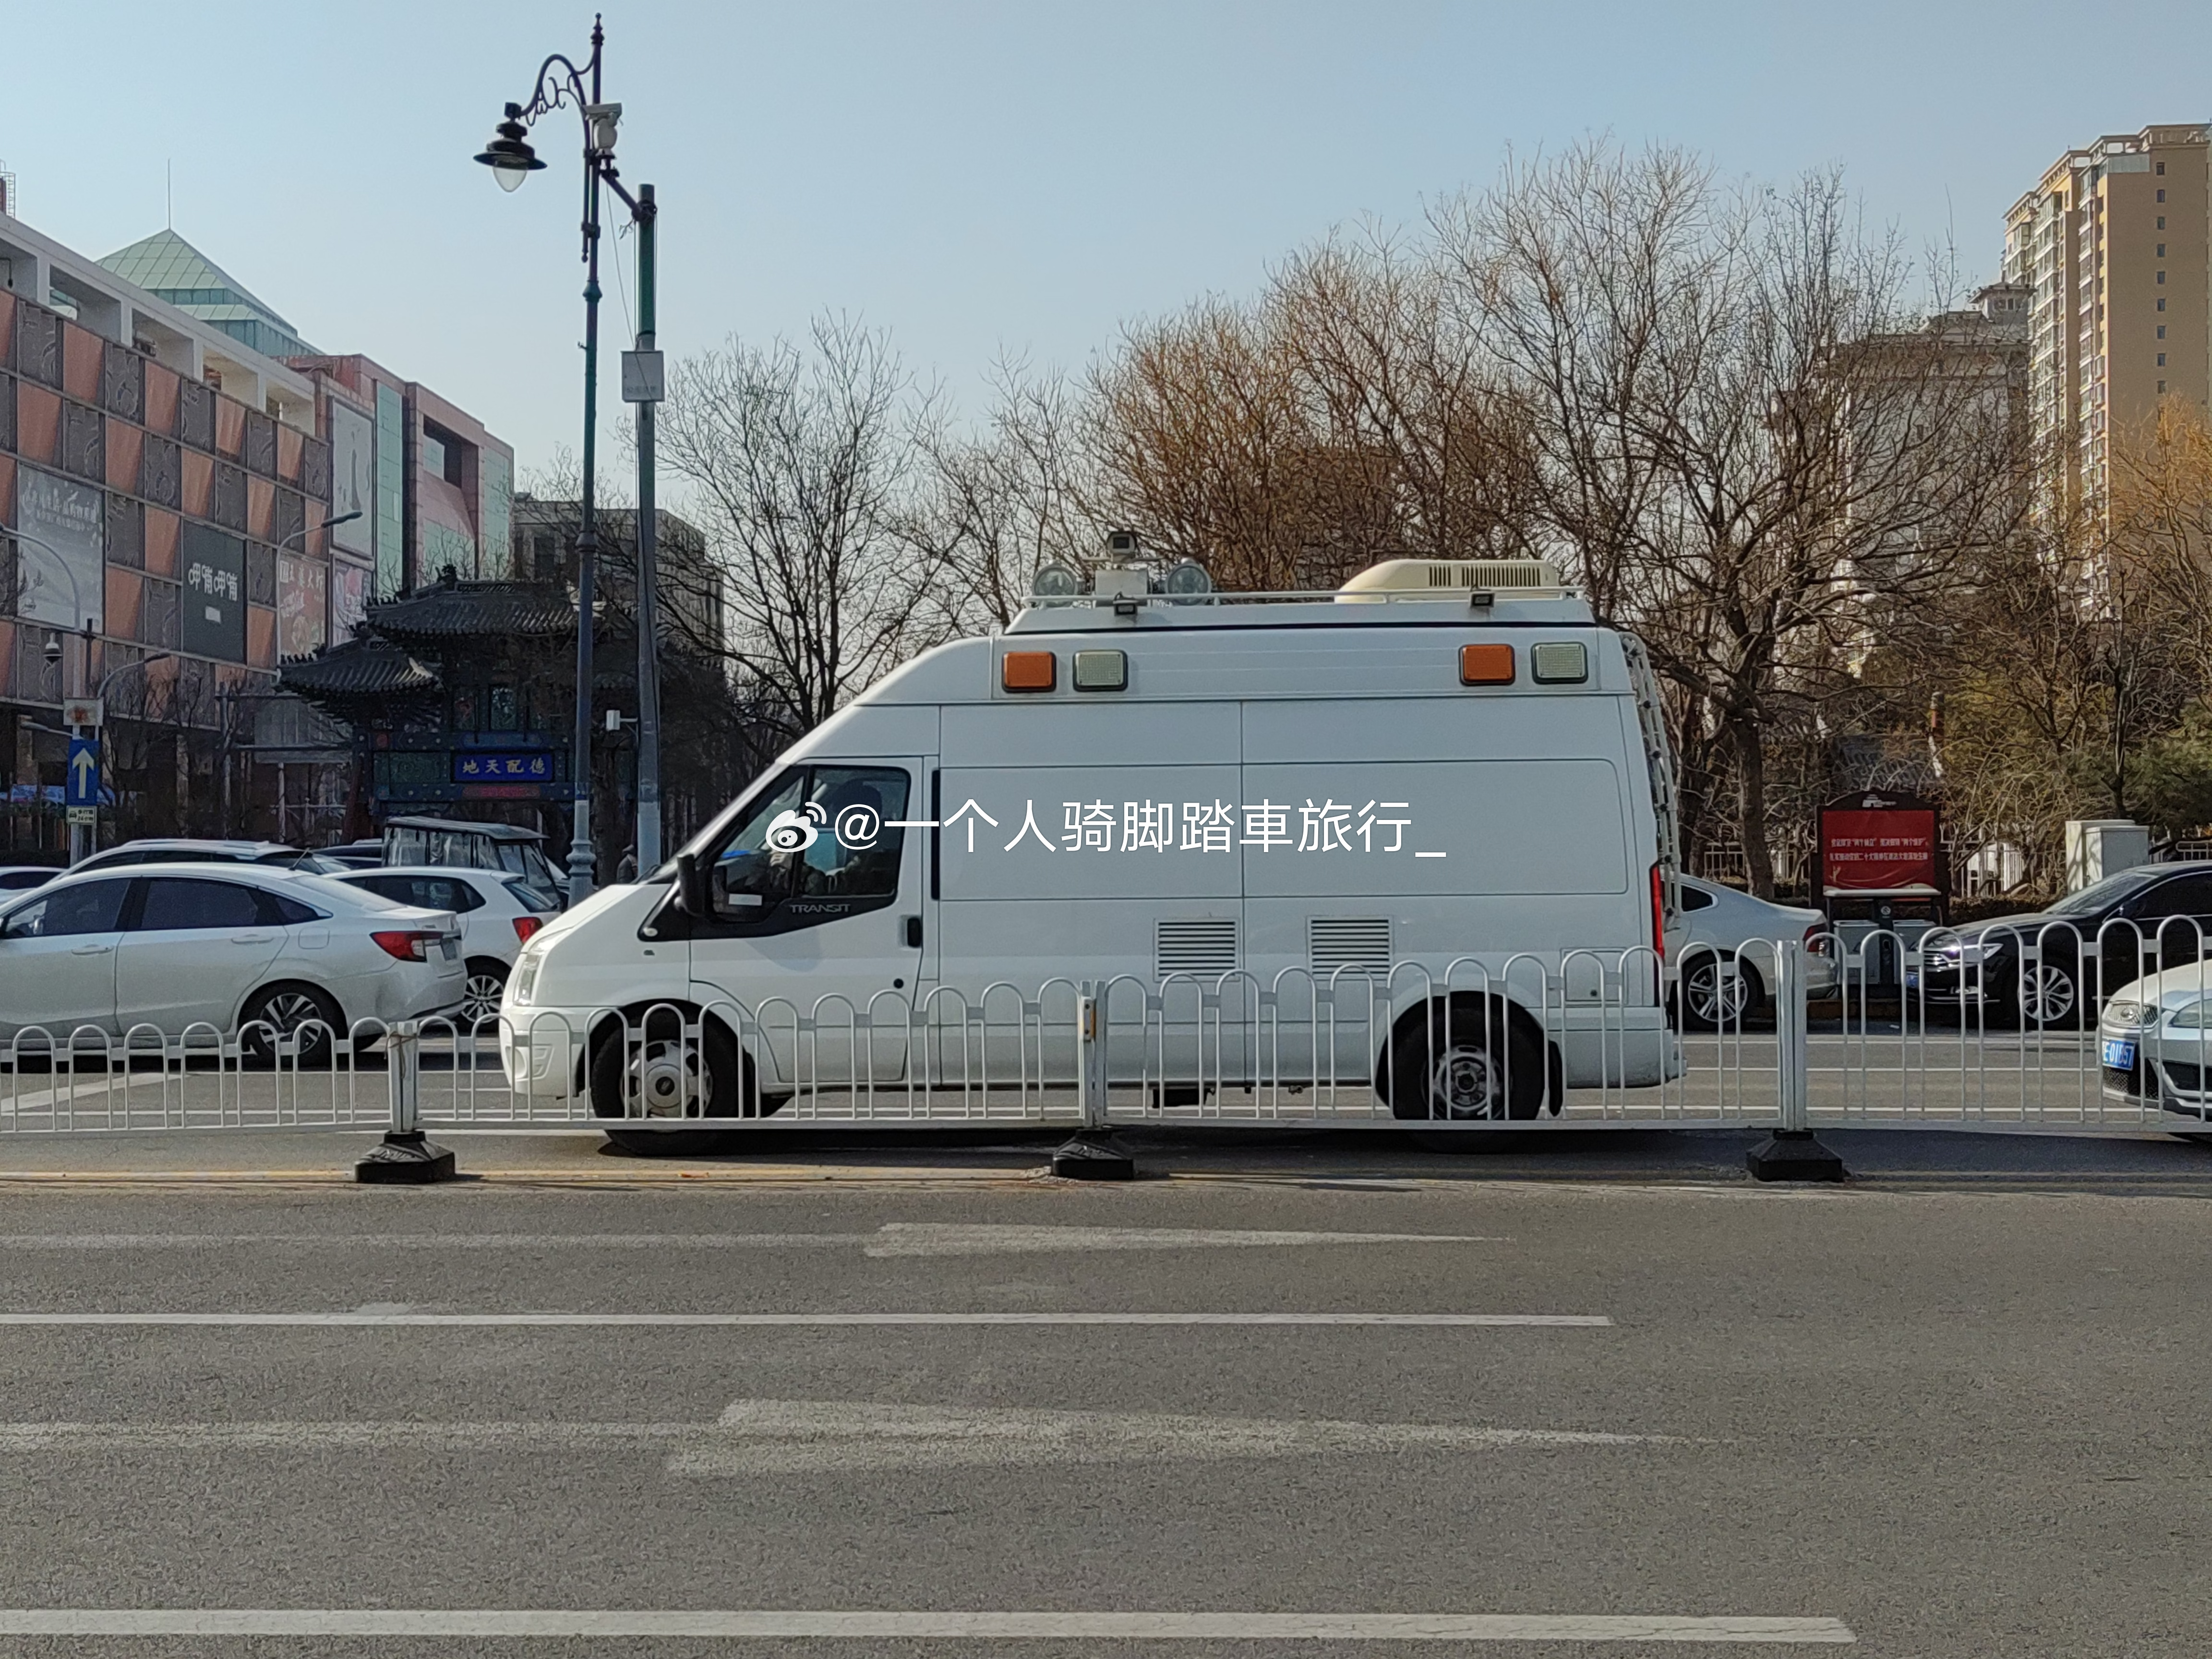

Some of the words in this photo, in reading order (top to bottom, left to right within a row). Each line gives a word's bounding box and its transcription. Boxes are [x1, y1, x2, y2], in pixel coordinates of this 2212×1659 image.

[188, 562, 238, 601] 呷哺呷哺
[789, 903, 851, 913] TRANSIT
